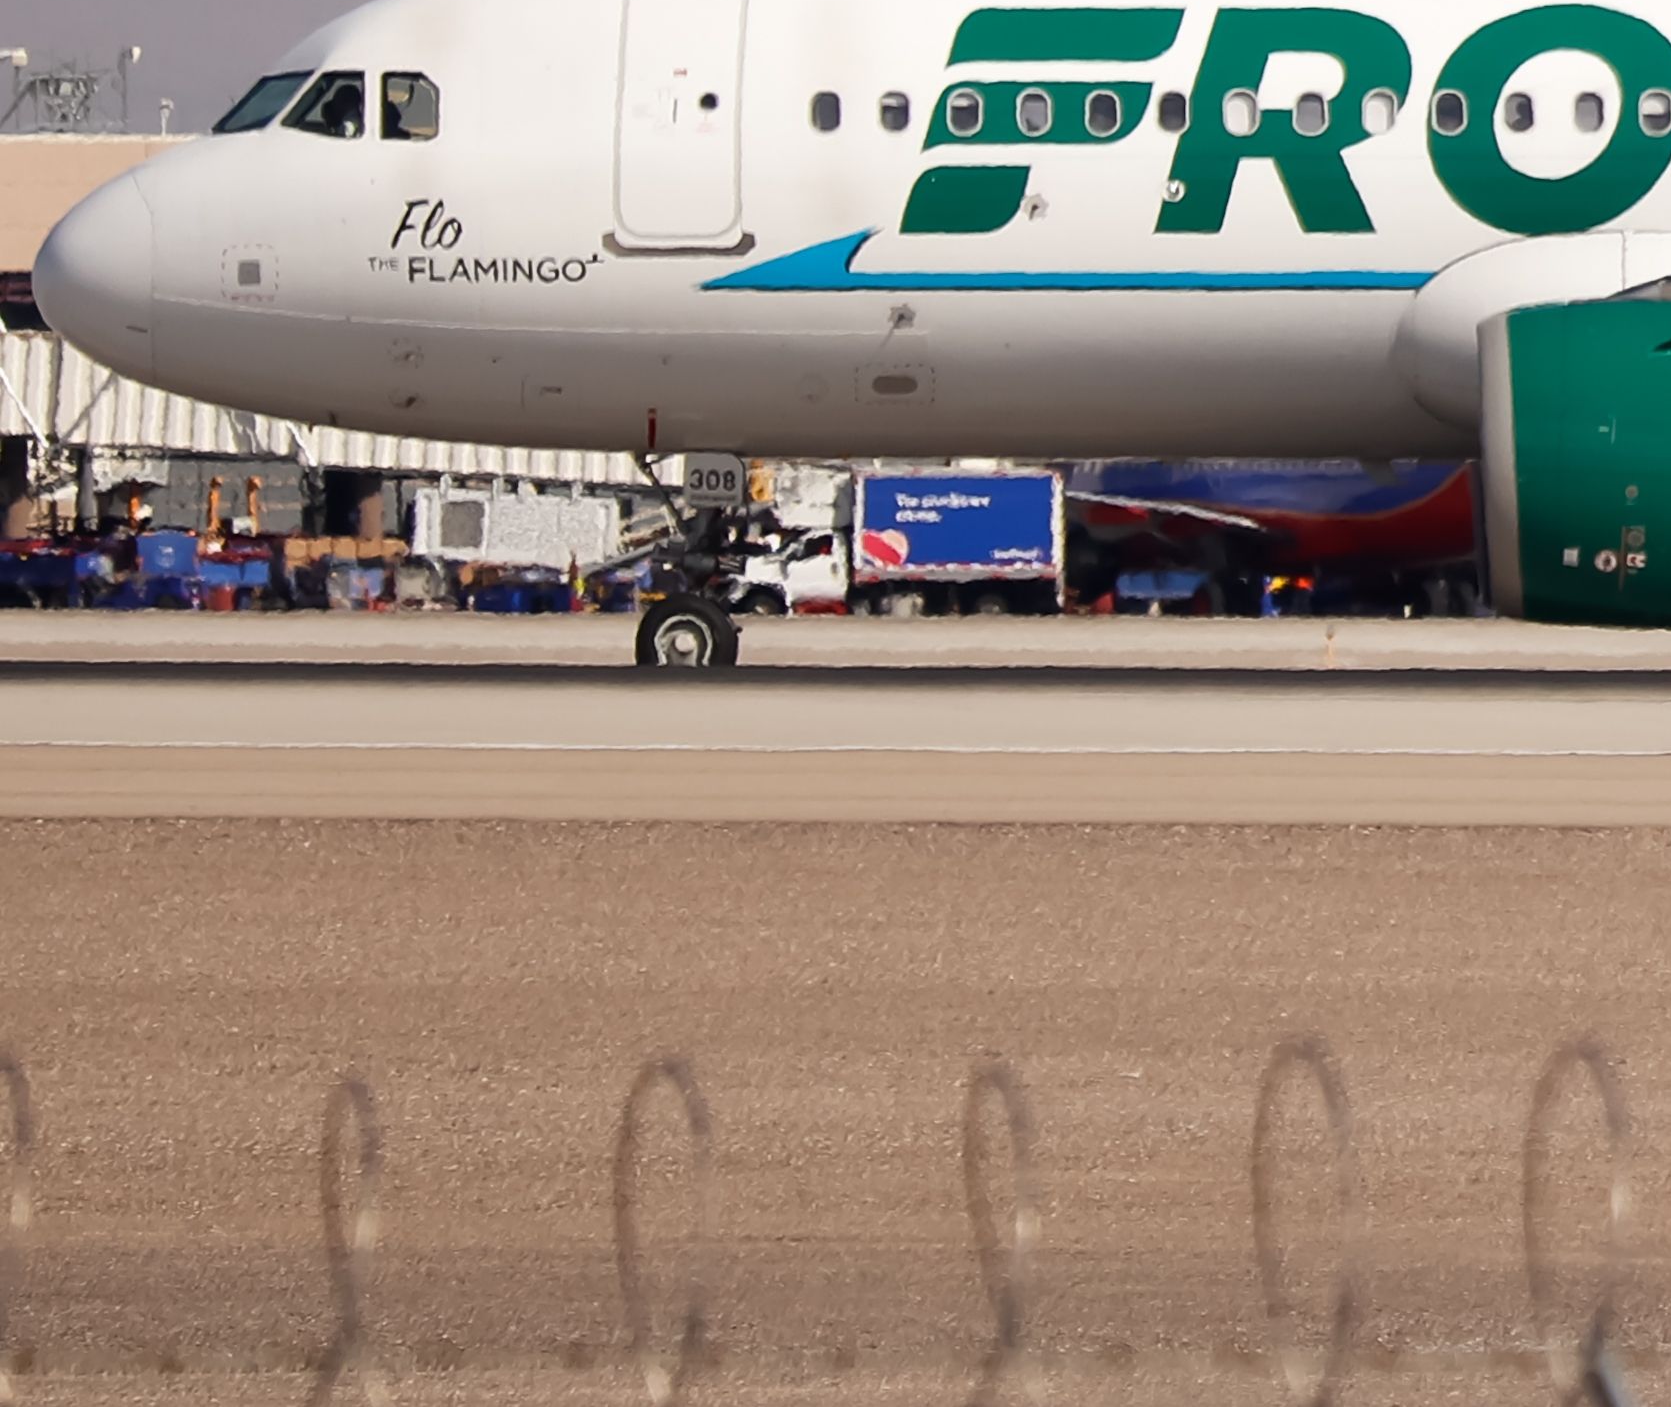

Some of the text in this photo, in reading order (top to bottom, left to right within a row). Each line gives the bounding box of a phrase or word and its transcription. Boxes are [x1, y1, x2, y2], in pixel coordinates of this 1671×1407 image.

[391, 199, 463, 249] Flo
[368, 256, 587, 283] THE FLAMINGO
[689, 469, 736, 491] 308
